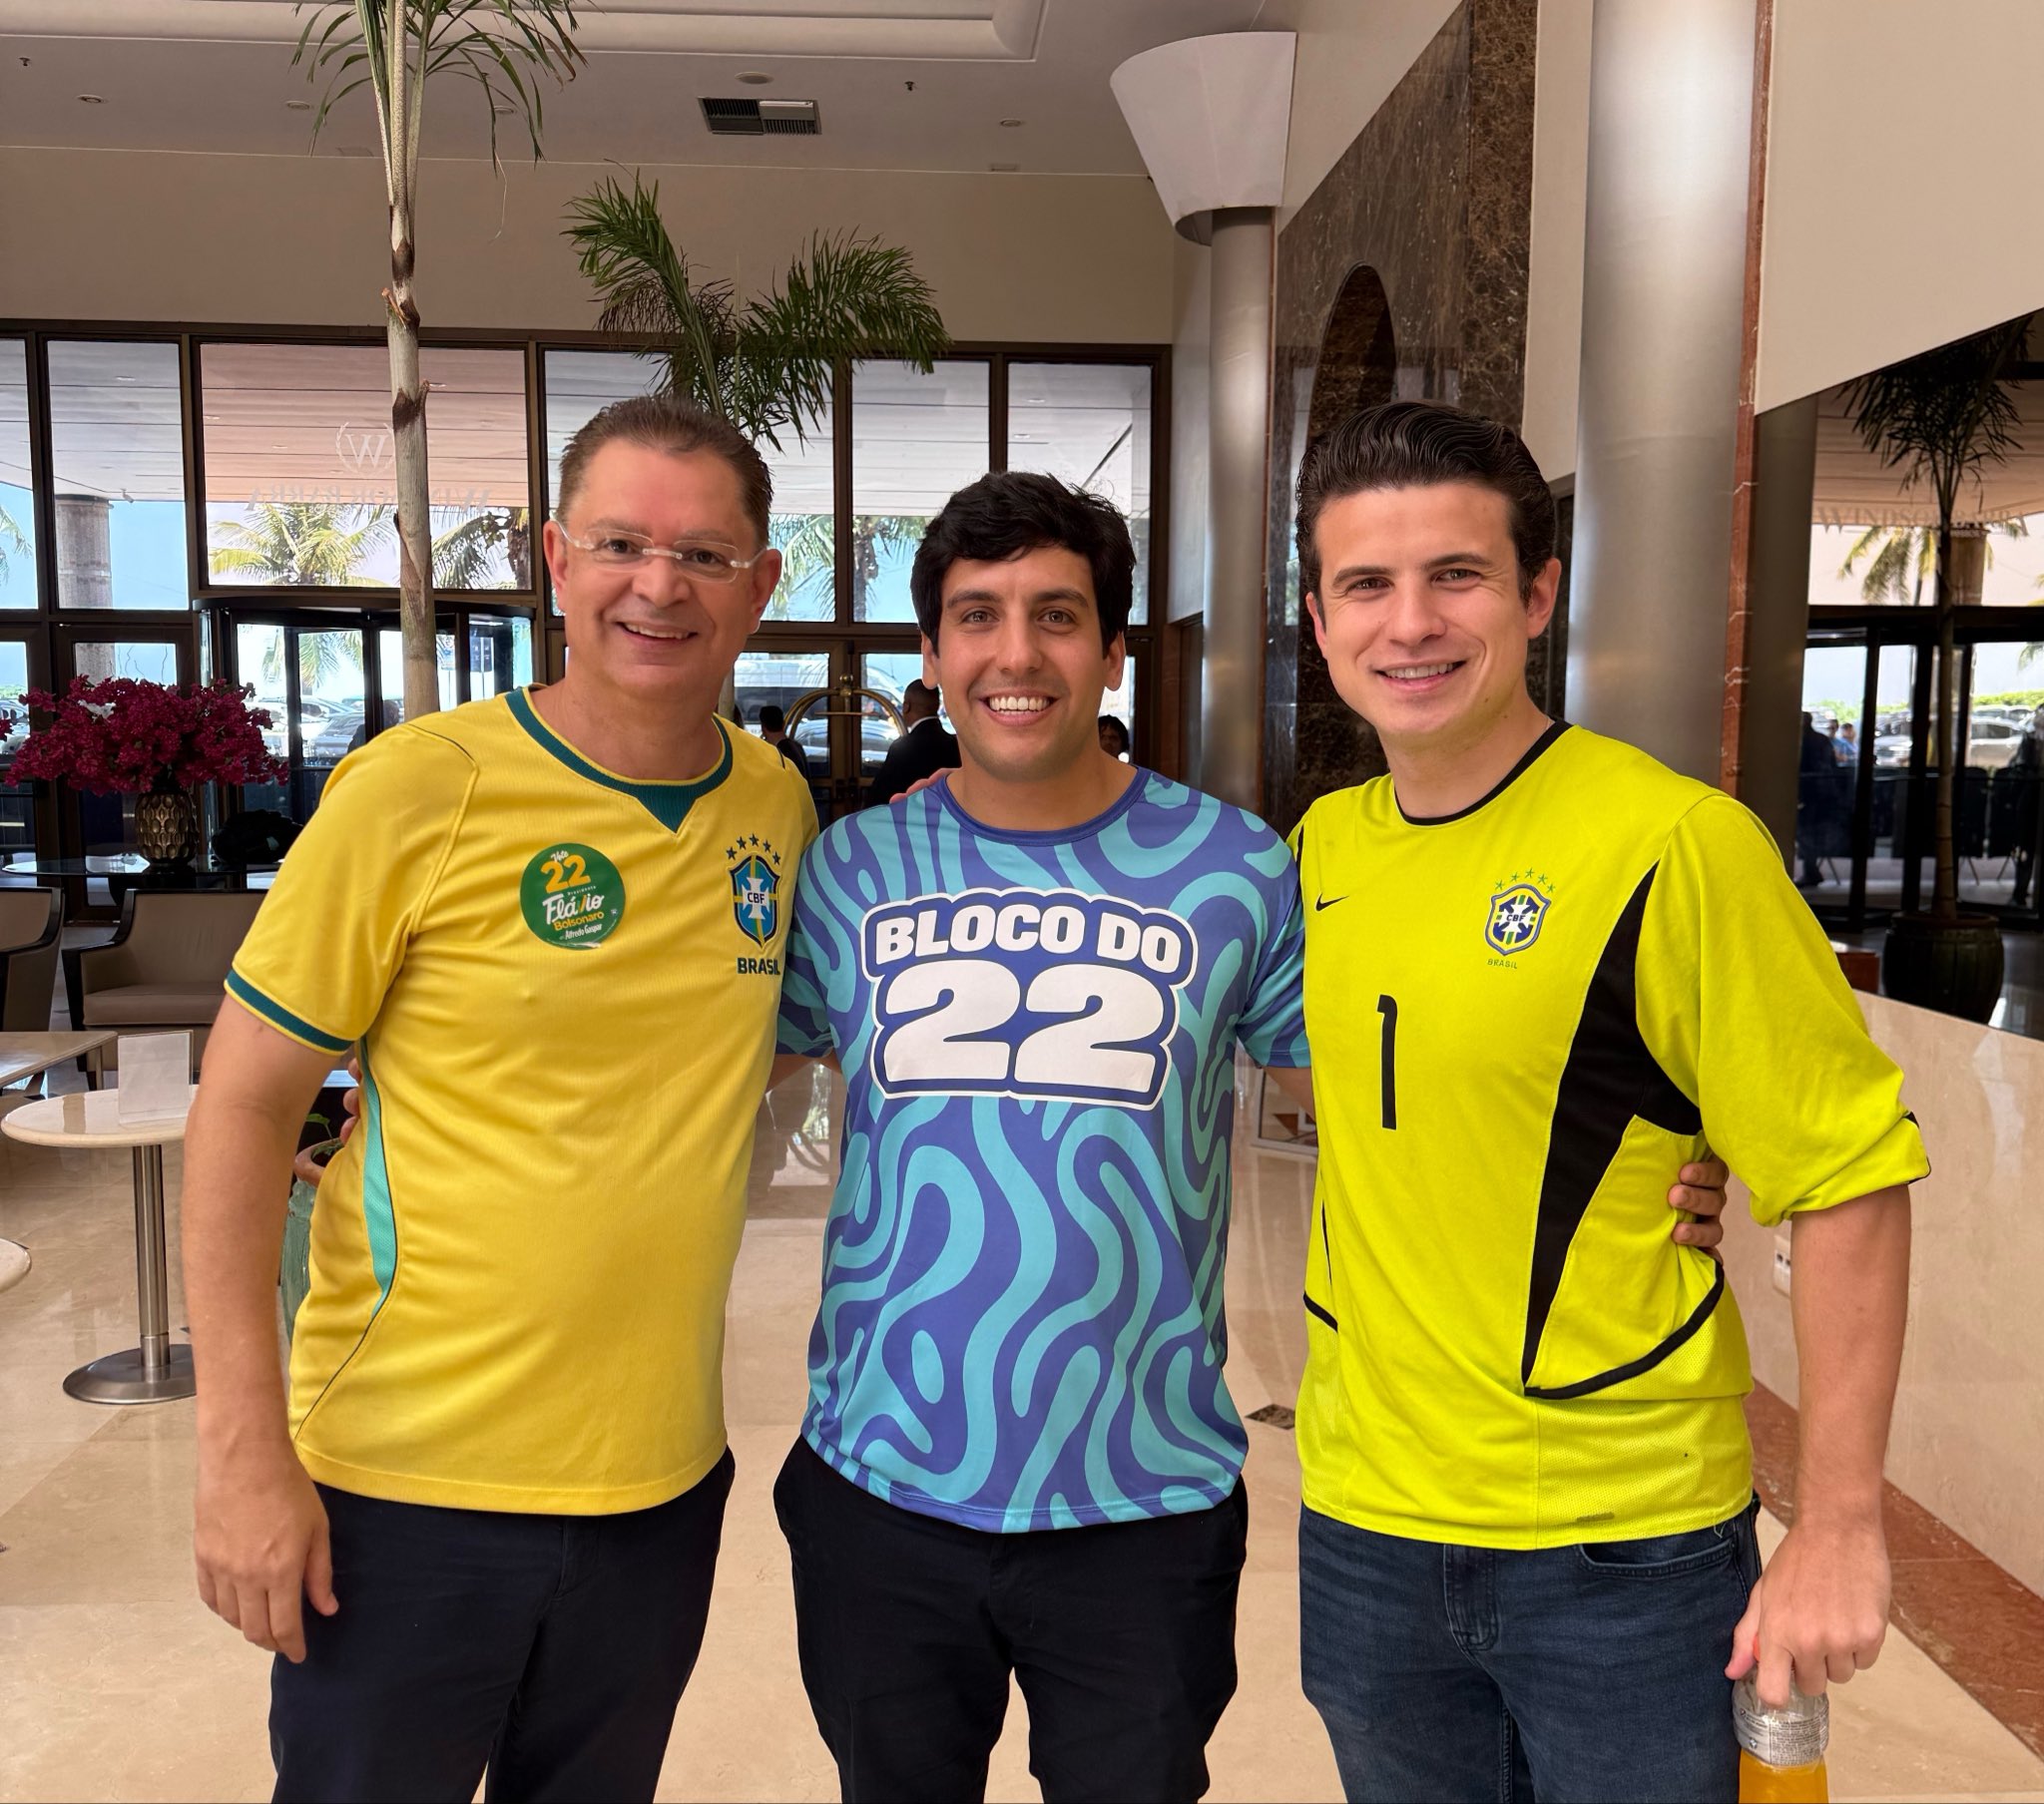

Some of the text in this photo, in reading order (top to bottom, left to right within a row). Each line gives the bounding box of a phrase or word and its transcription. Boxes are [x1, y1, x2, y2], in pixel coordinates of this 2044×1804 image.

[540, 854, 592, 894] 22
[747, 892, 766, 904] CBF
[553, 911, 605, 931] Bolsonaro
[875, 903, 1182, 974] BLOCO DO
[737, 957, 781, 976] BRASIL
[1487, 958, 1518, 970] BRASIL
[884, 959, 1165, 1094] 22
[1376, 994, 1398, 1130] 1
